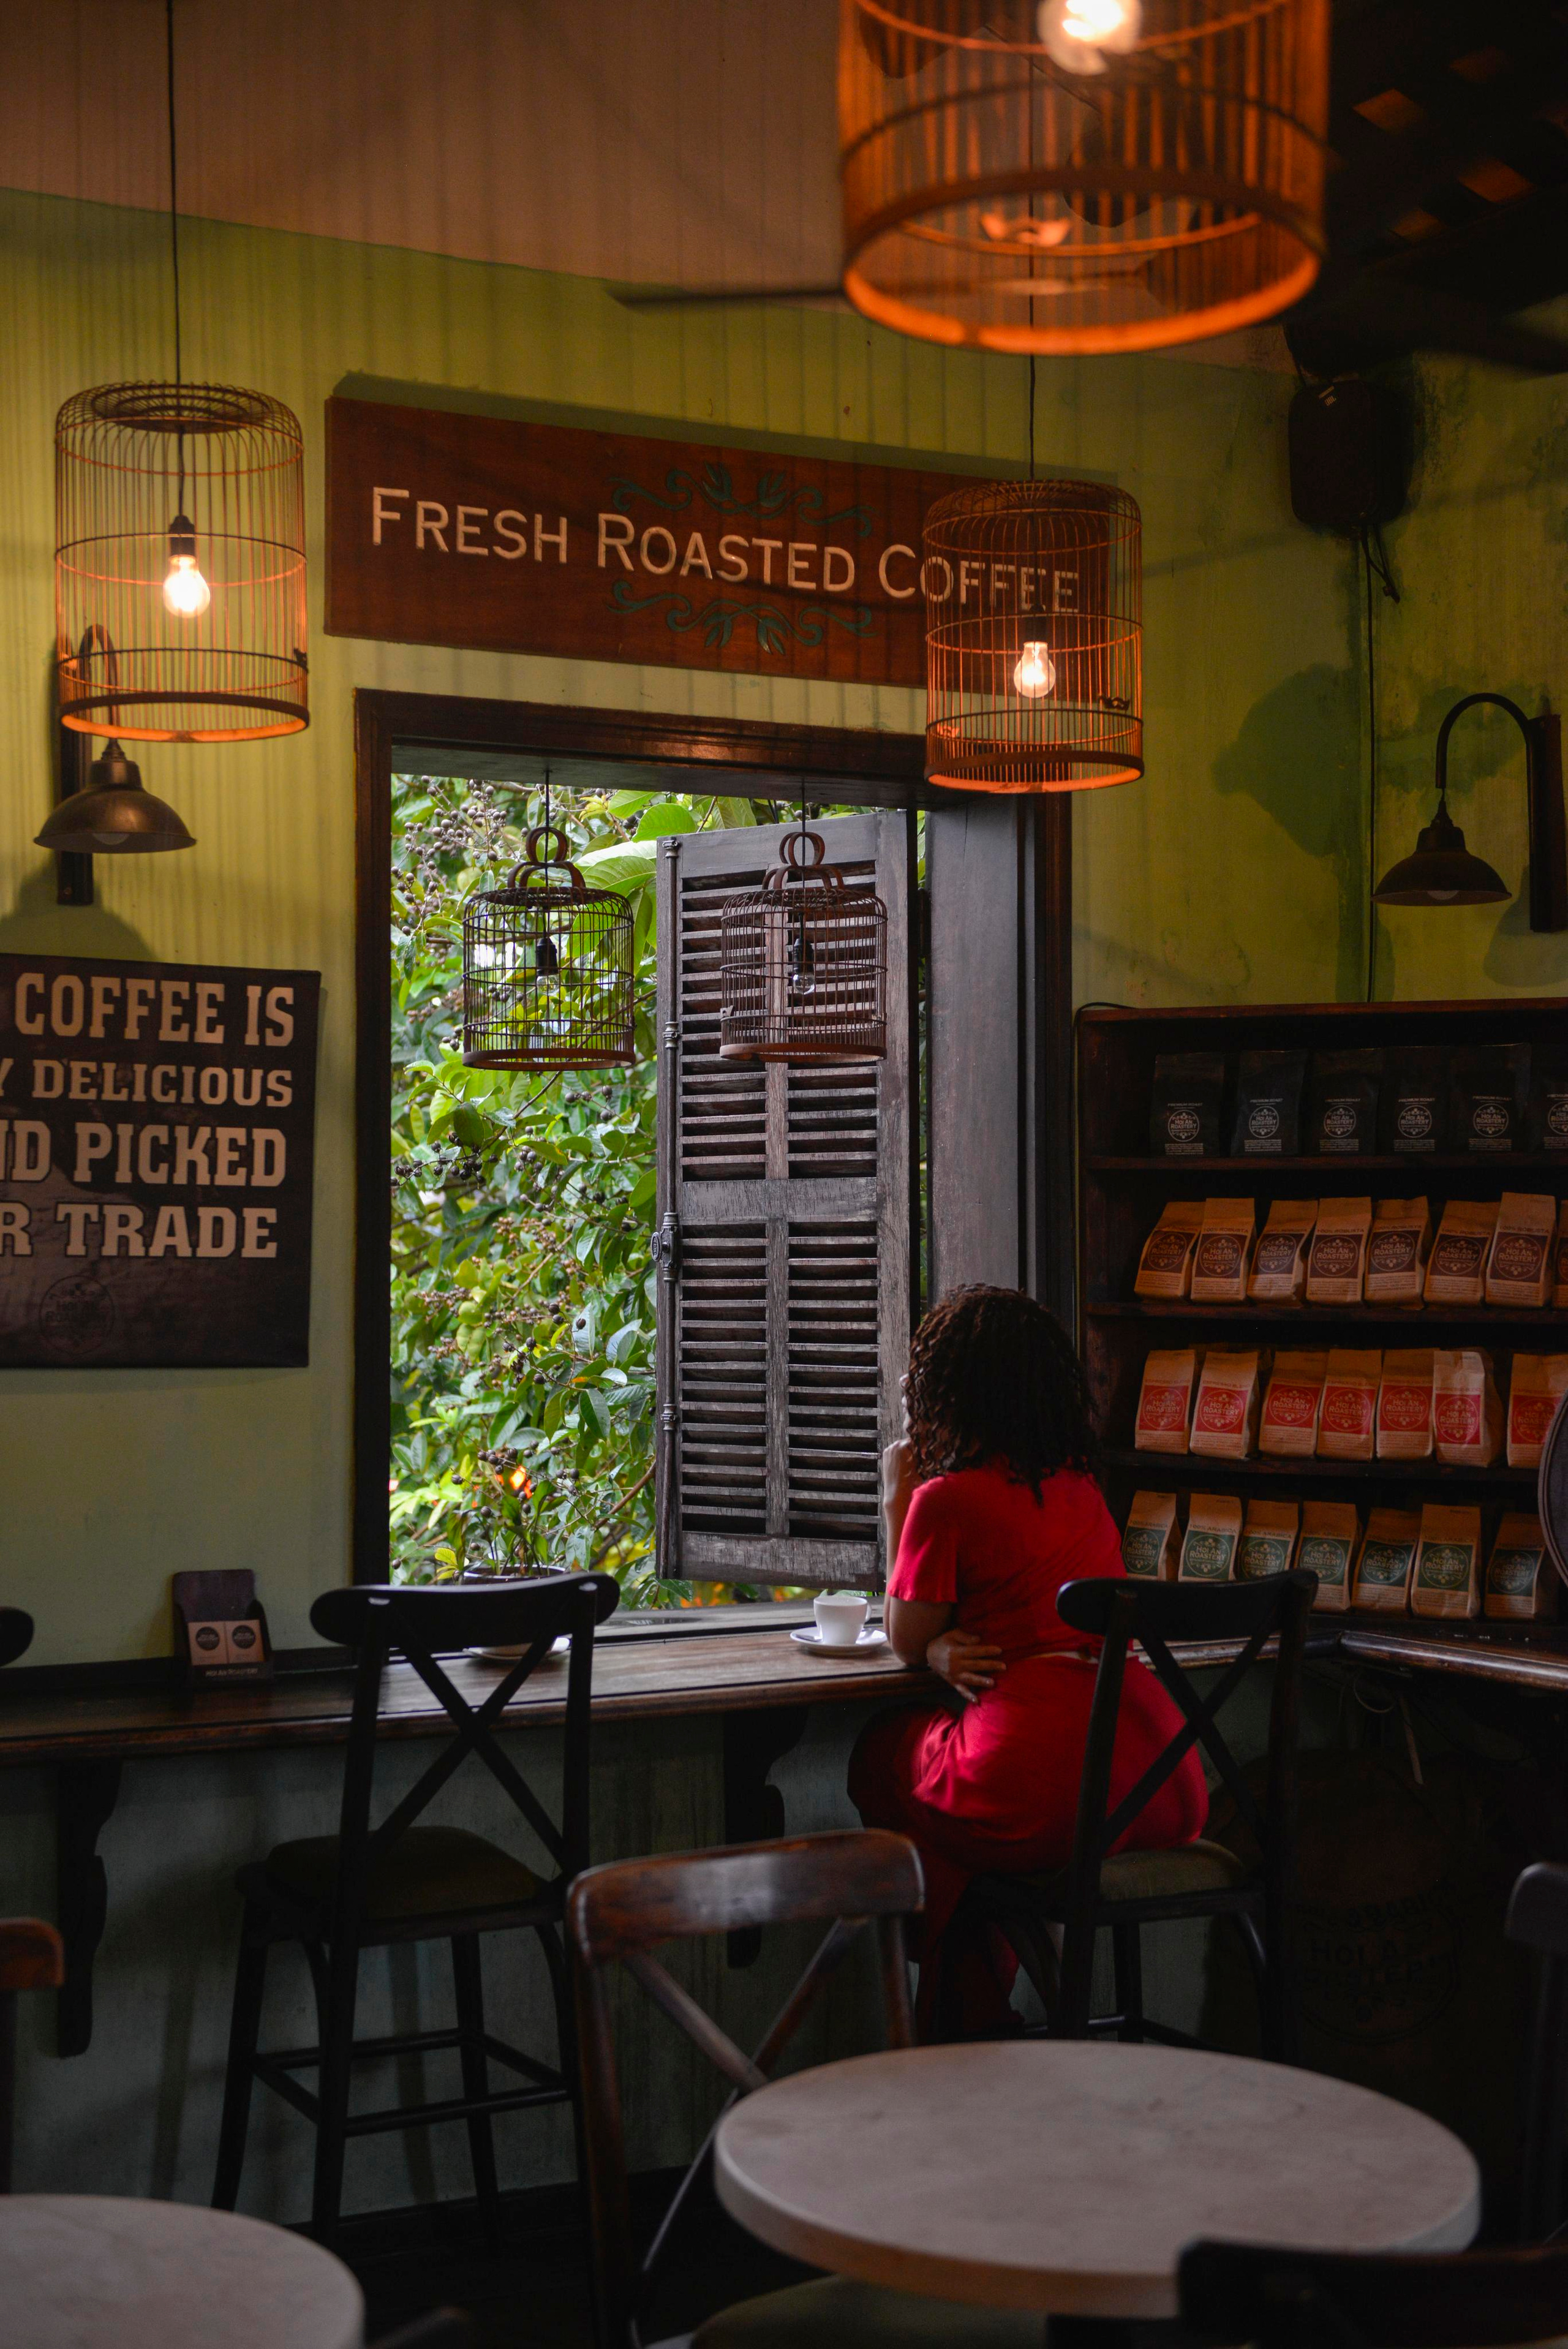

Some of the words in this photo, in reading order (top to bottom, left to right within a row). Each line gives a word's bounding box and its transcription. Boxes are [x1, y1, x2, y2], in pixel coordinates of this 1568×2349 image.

[372, 487, 568, 565] FRESH
[598, 511, 856, 594] ROASTED
[879, 544, 1079, 613] COFFEE
[15, 973, 225, 1044] COFFEE
[245, 986, 294, 1047] IS
[32, 1059, 293, 1107] DELICIOUS
[74, 1122, 287, 1187] PICKED
[56, 1203, 278, 1258] TRADE
[1189, 1550, 1226, 1561] ROASTERY
[1303, 1555, 1341, 1566] ROASTERY
